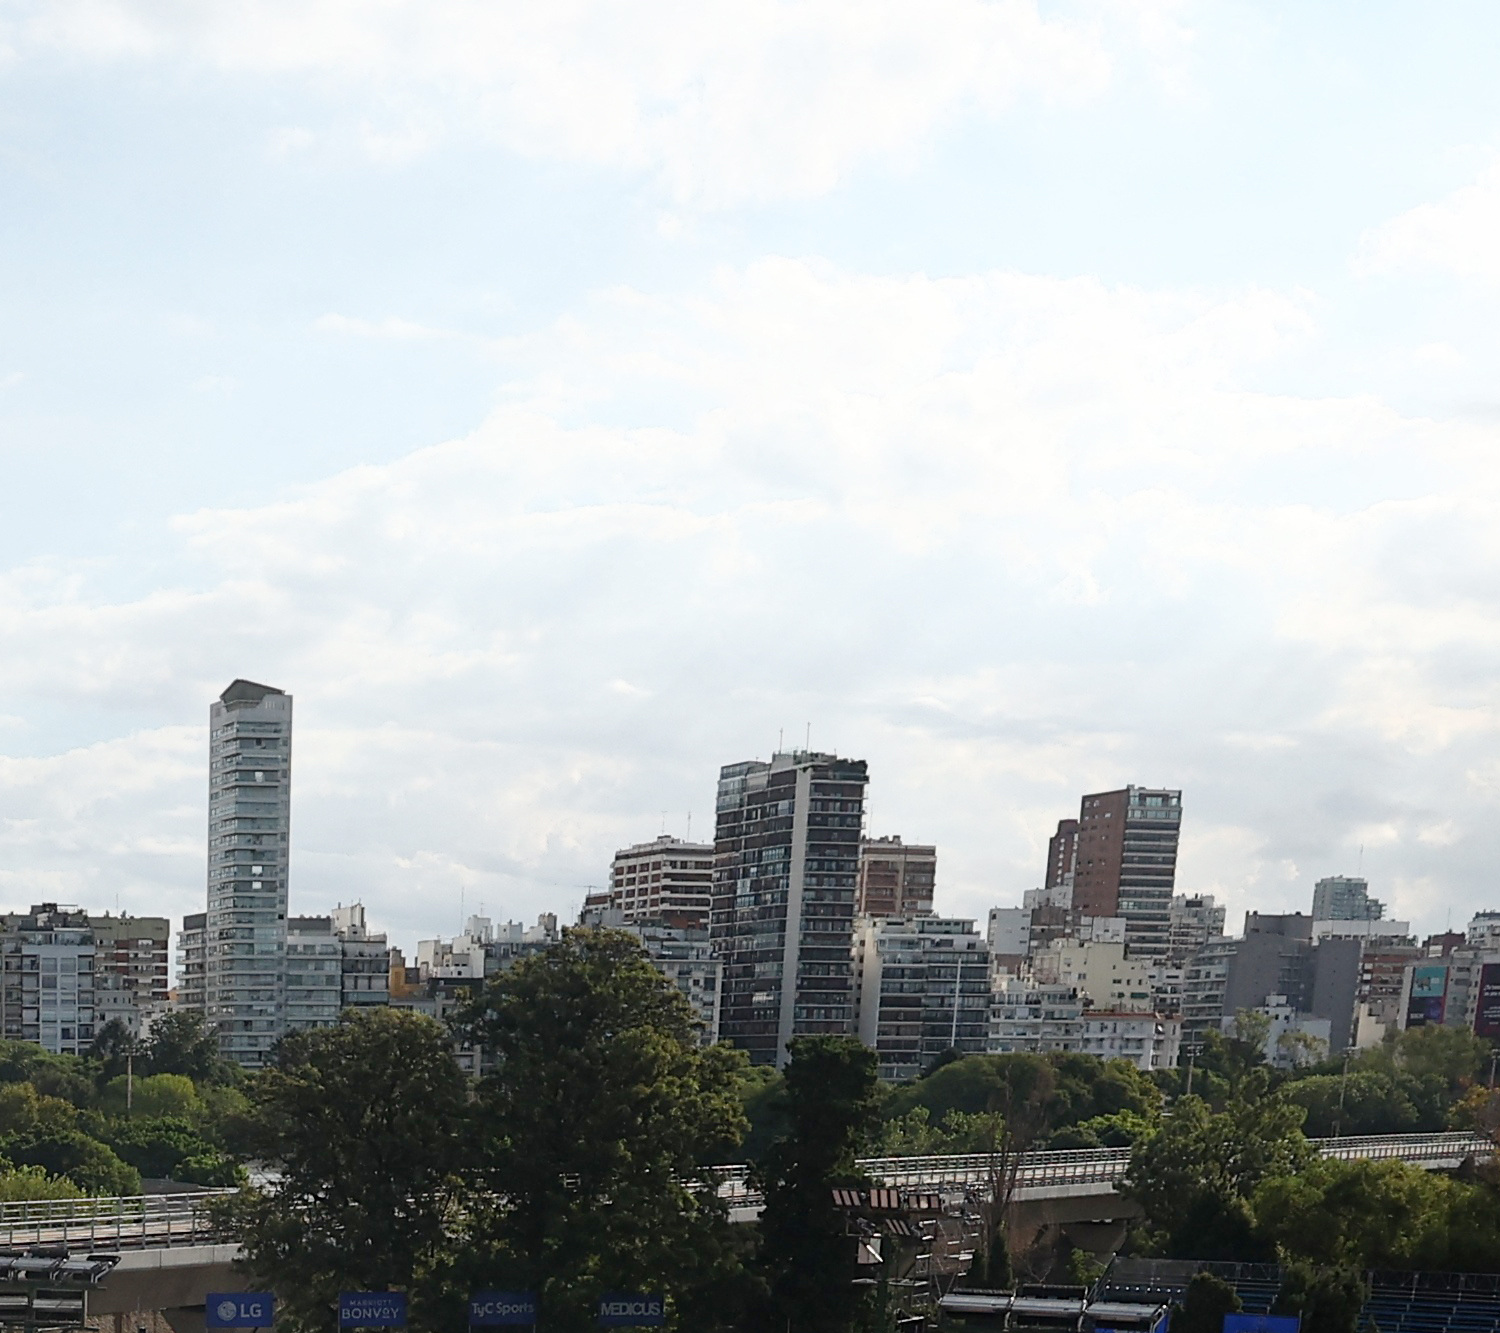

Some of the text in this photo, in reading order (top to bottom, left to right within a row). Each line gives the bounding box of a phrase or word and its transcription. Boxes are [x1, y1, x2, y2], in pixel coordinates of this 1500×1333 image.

[240, 1302, 262, 1319] LG
[341, 1306, 400, 1320] BONVOY
[471, 1301, 535, 1316] TyC Sports
[601, 1302, 661, 1317] MEDICUS
